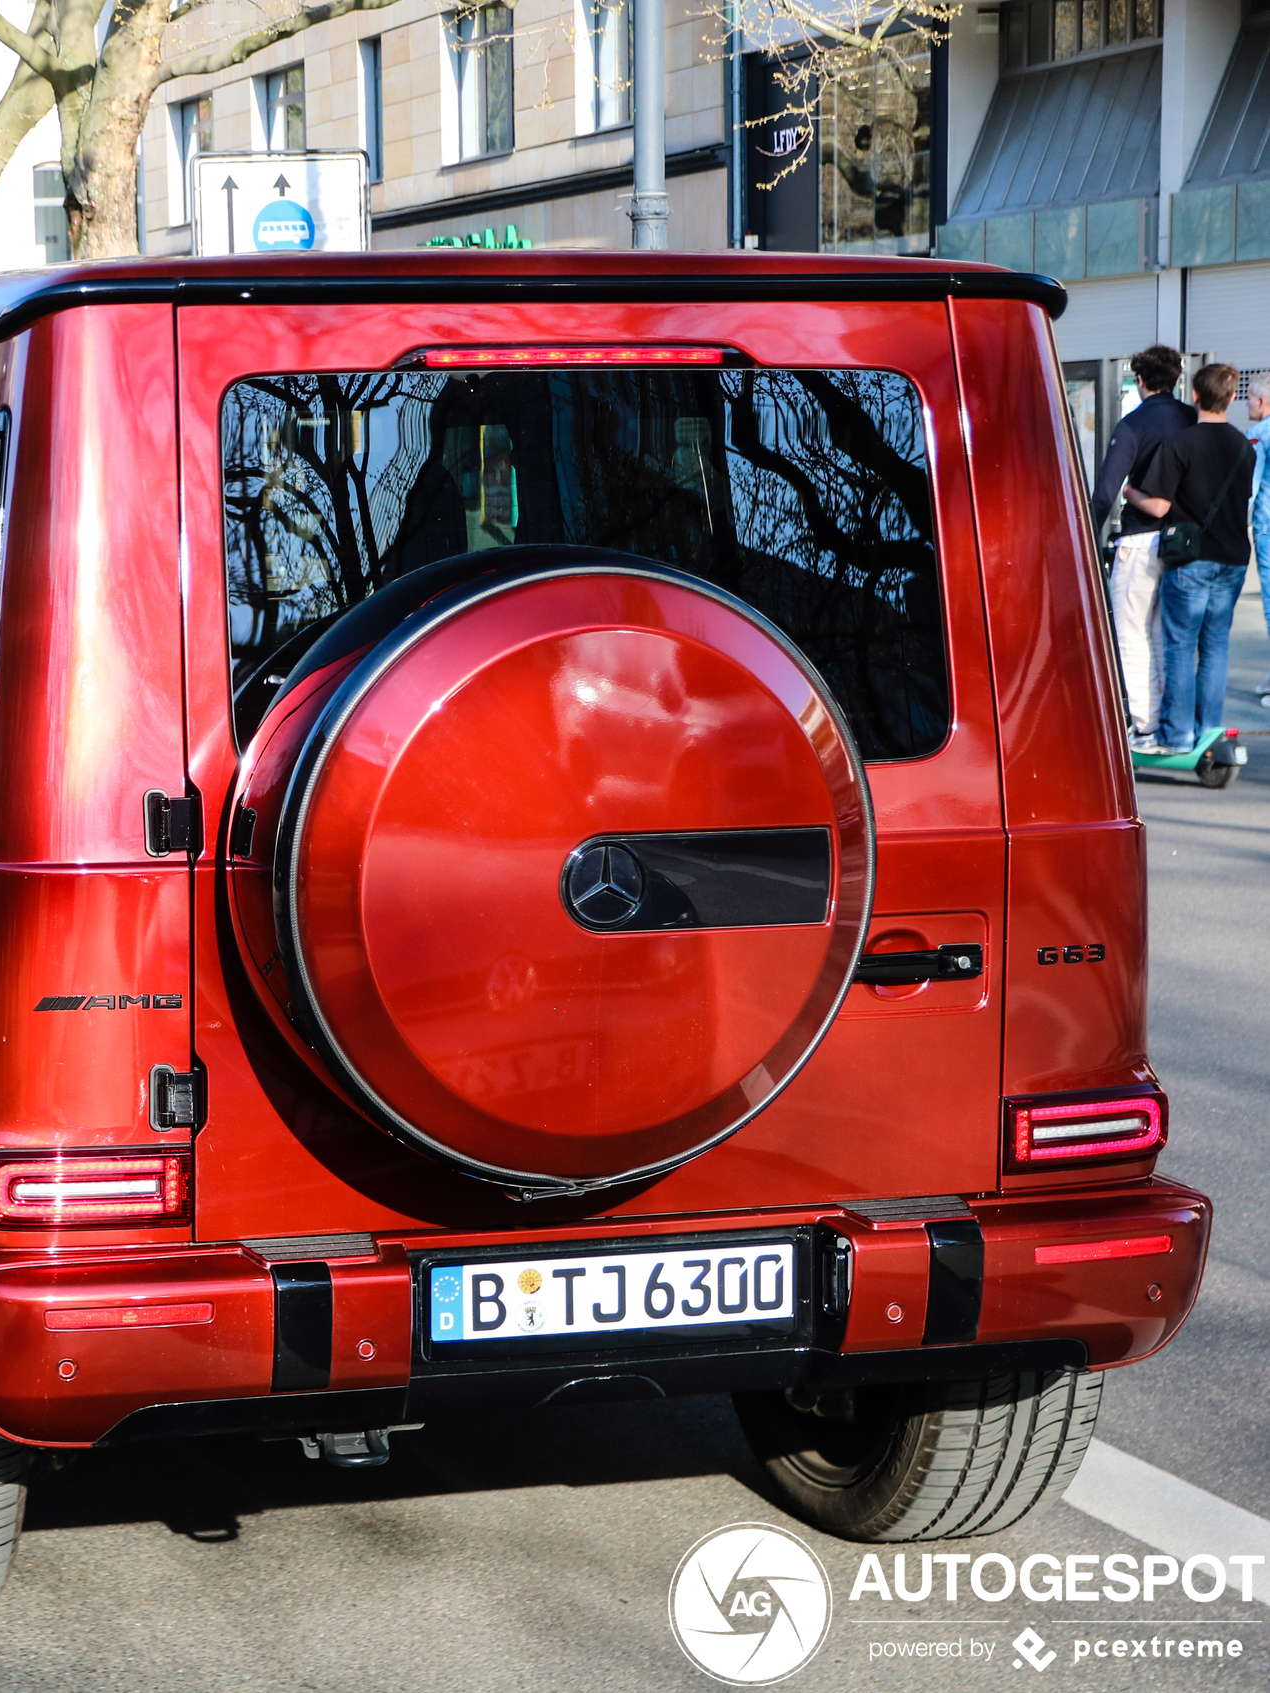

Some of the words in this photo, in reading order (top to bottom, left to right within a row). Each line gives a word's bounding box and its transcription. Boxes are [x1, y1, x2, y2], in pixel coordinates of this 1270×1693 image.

[773, 127, 798, 153] LFDY
[82, 994, 183, 1011] AMG
[471, 1273, 507, 1332] B
[552, 1265, 626, 1326] TJ
[644, 1254, 784, 1319] 6300
[440, 1312, 454, 1331] D
